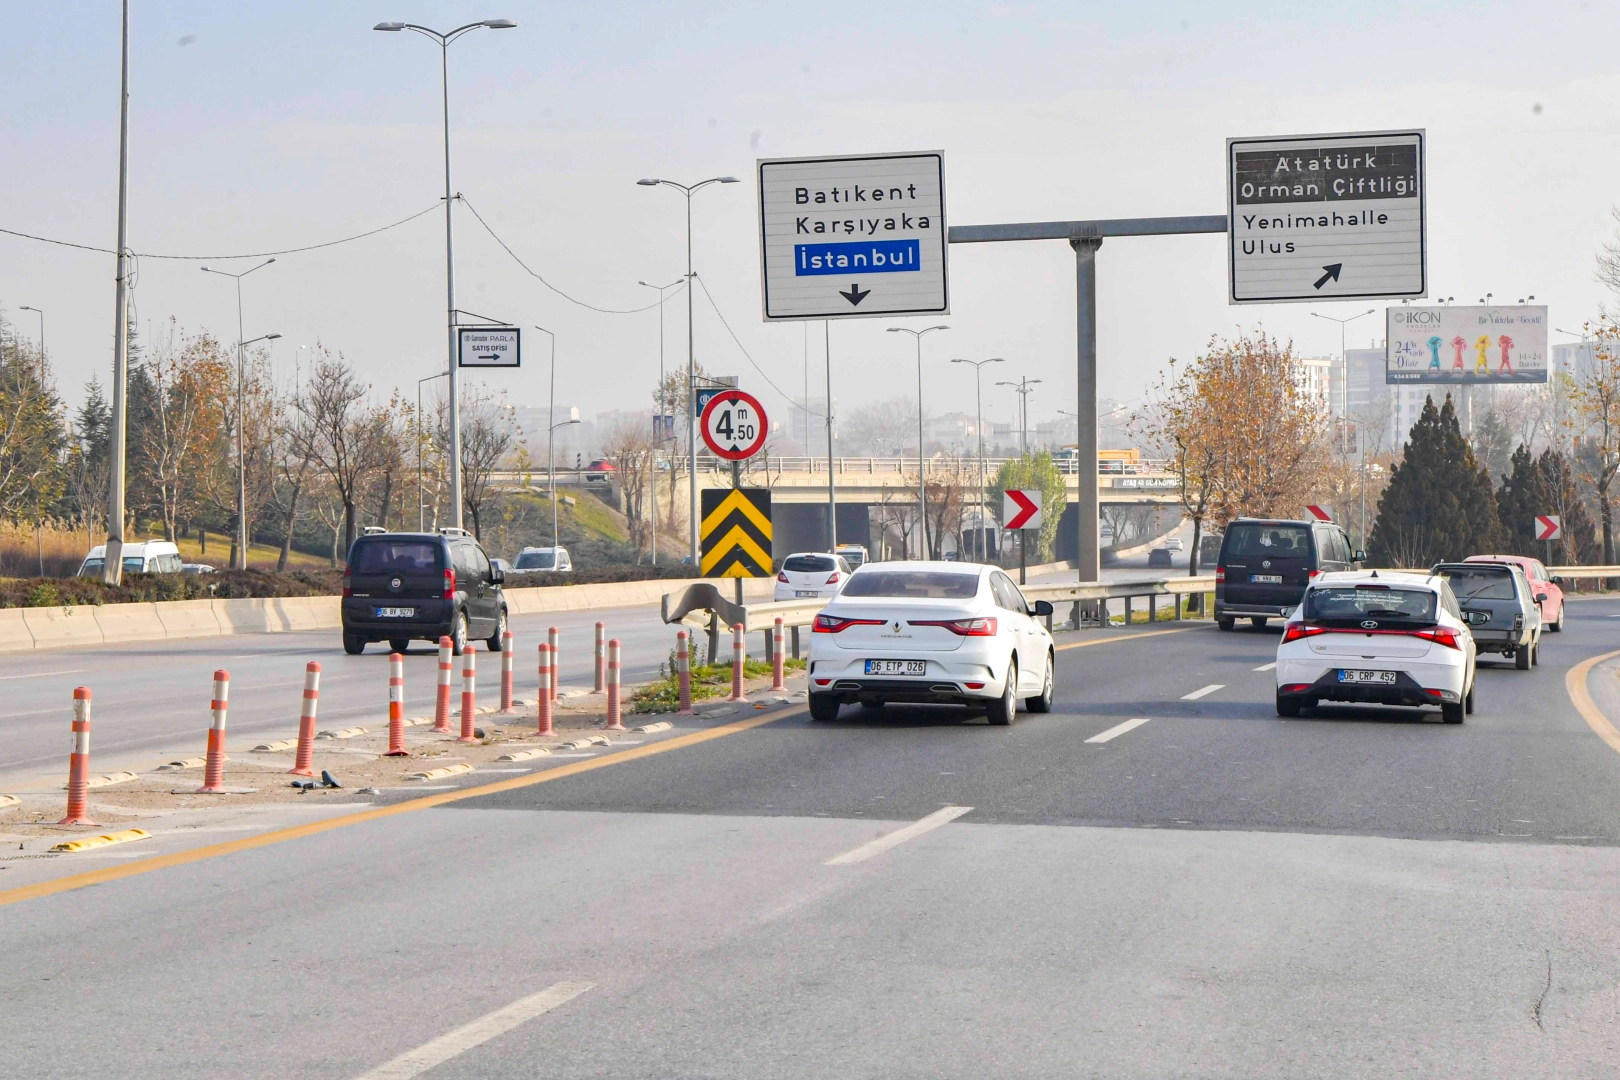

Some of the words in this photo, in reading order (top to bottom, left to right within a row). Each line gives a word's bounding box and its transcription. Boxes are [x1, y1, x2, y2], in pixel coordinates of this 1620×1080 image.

[1275, 153, 1377, 172] Atatürk
[795, 183, 917, 204] Batıkent
[1241, 182, 1319, 198] Orman
[1333, 175, 1415, 197] Çiftliği
[796, 212, 930, 236] Karşıyaka
[1243, 210, 1388, 230] Yenimahalle
[1242, 239, 1296, 255] Ulus
[801, 246, 914, 269] İstanbul
[472, 344, 490, 352] SATIŞ
[1394, 341, 1411, 354] 24
[1122, 479, 1137, 488] AYAŞ
[871, 661, 882, 671] 06
[886, 661, 903, 671] ETP
[906, 662, 924, 672] 026
[1344, 670, 1354, 680] 06
[1359, 671, 1375, 681] CRP
[1379, 672, 1395, 682] 452
